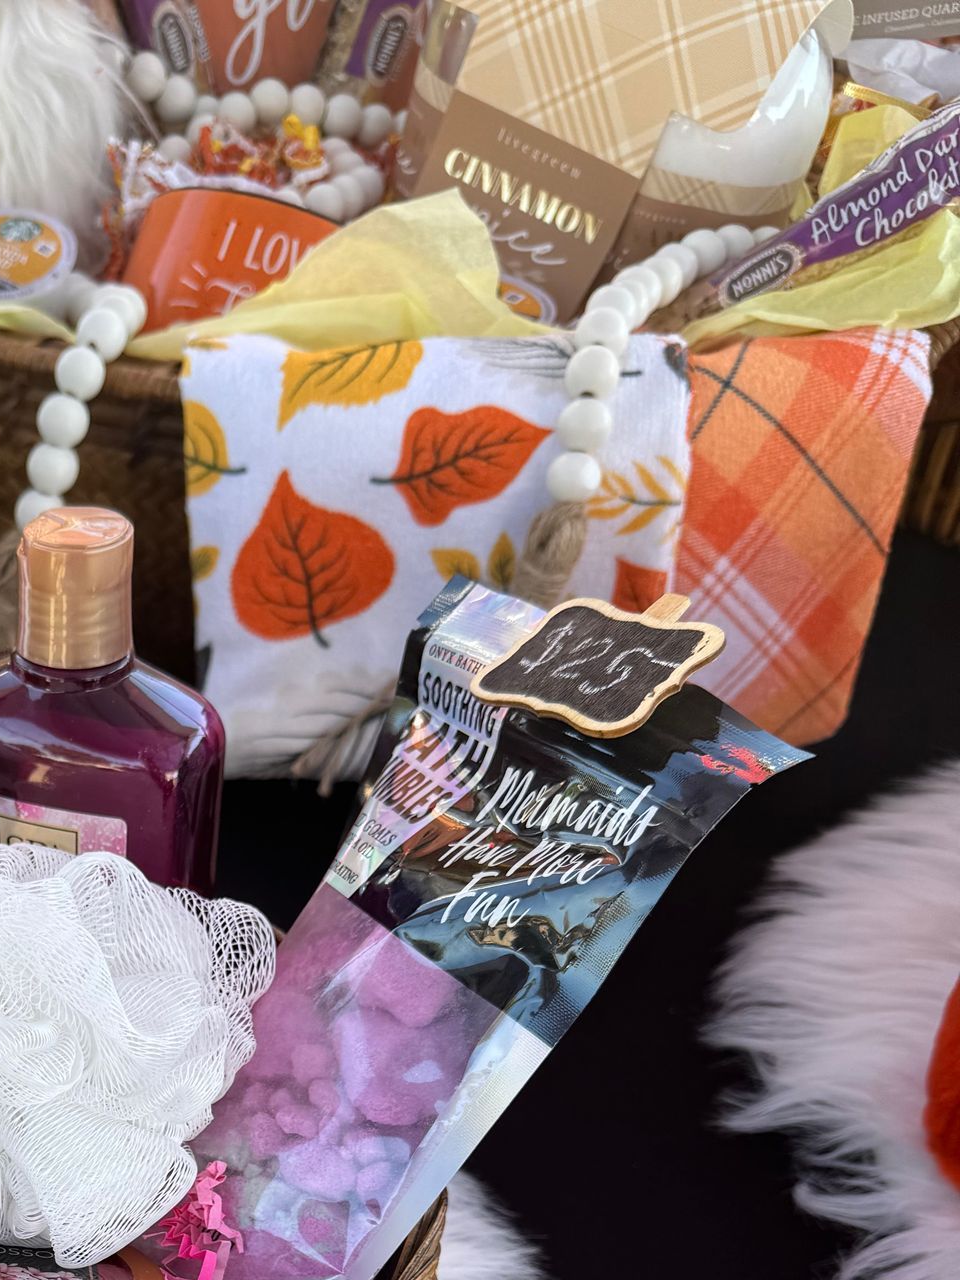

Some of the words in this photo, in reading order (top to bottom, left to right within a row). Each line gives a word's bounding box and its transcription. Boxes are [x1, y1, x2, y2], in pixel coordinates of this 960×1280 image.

[862, 8, 919, 25] INFUSED
[922, 2, 960, 18] QUAR
[444, 148, 604, 245] CINNAMON
[811, 158, 913, 245] Almond
[915, 128, 960, 174] Dar
[855, 156, 960, 247] Chocolat
[217, 218, 238, 262] I
[243, 225, 315, 276] LOV
[731, 254, 789, 298] NONNI'S
[428, 644, 457, 662] ONYX
[518, 620, 683, 696] $25
[422, 671, 501, 738] SOOTHING
[402, 712, 489, 789] ATH
[363, 819, 397, 846] GOALS
[475, 766, 665, 847] Mermaids
[438, 826, 519, 868] Have
[505, 837, 606, 885] More
[440, 870, 532, 928] Fun
